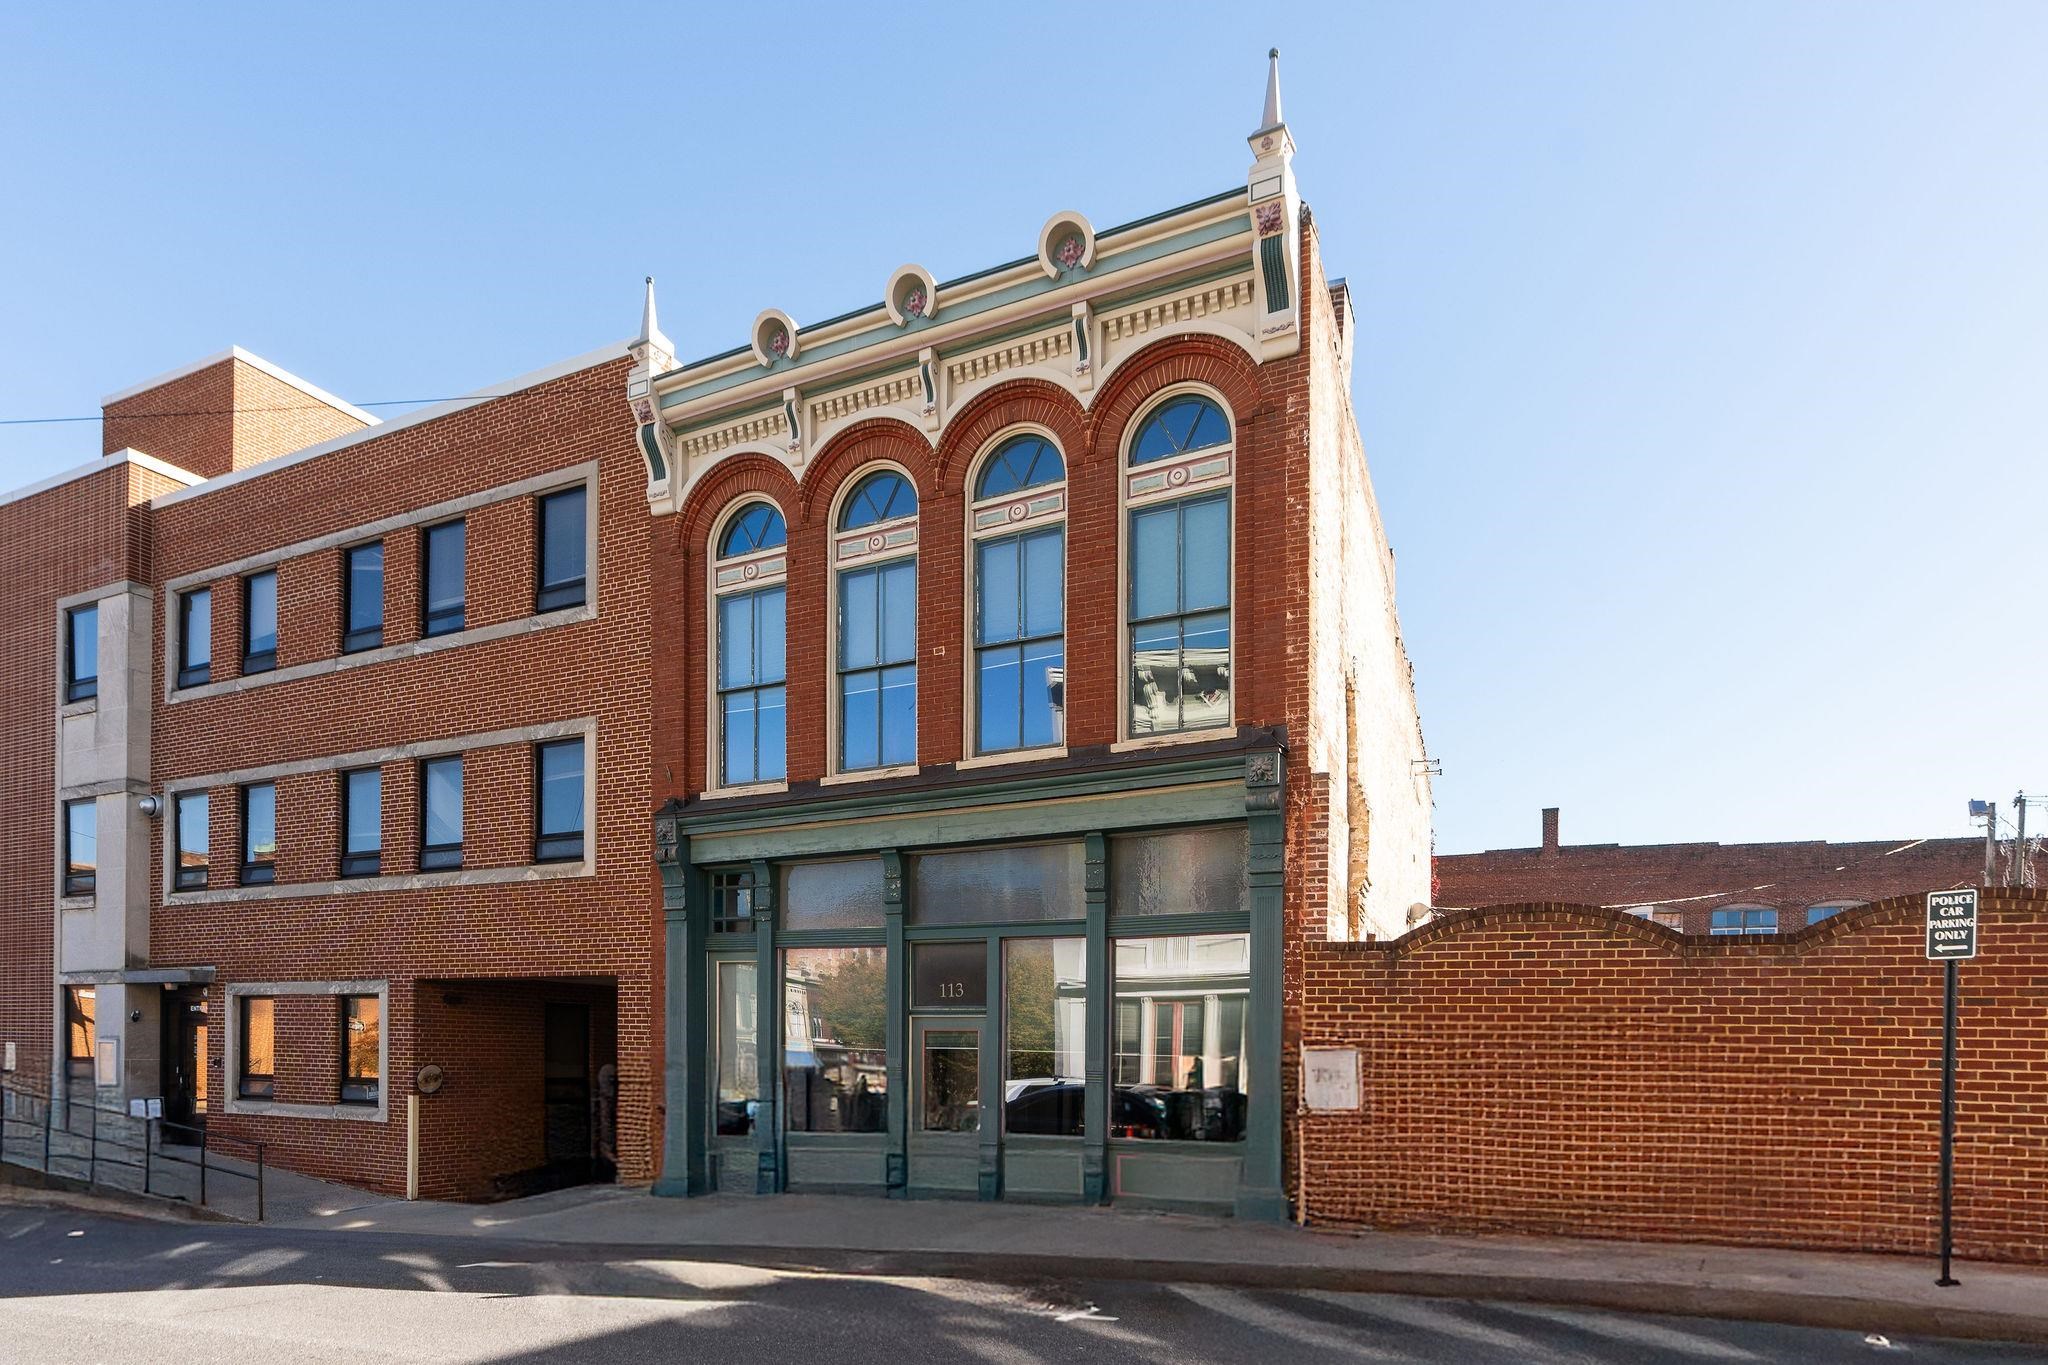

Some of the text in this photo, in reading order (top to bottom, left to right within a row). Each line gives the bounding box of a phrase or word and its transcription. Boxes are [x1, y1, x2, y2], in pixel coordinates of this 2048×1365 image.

[1931, 894, 1974, 906] POLICE
[1939, 906, 1964, 917] CAR
[1929, 918, 1974, 929] PARKING
[1934, 930, 1968, 940] ONLY
[940, 982, 964, 998] 113
